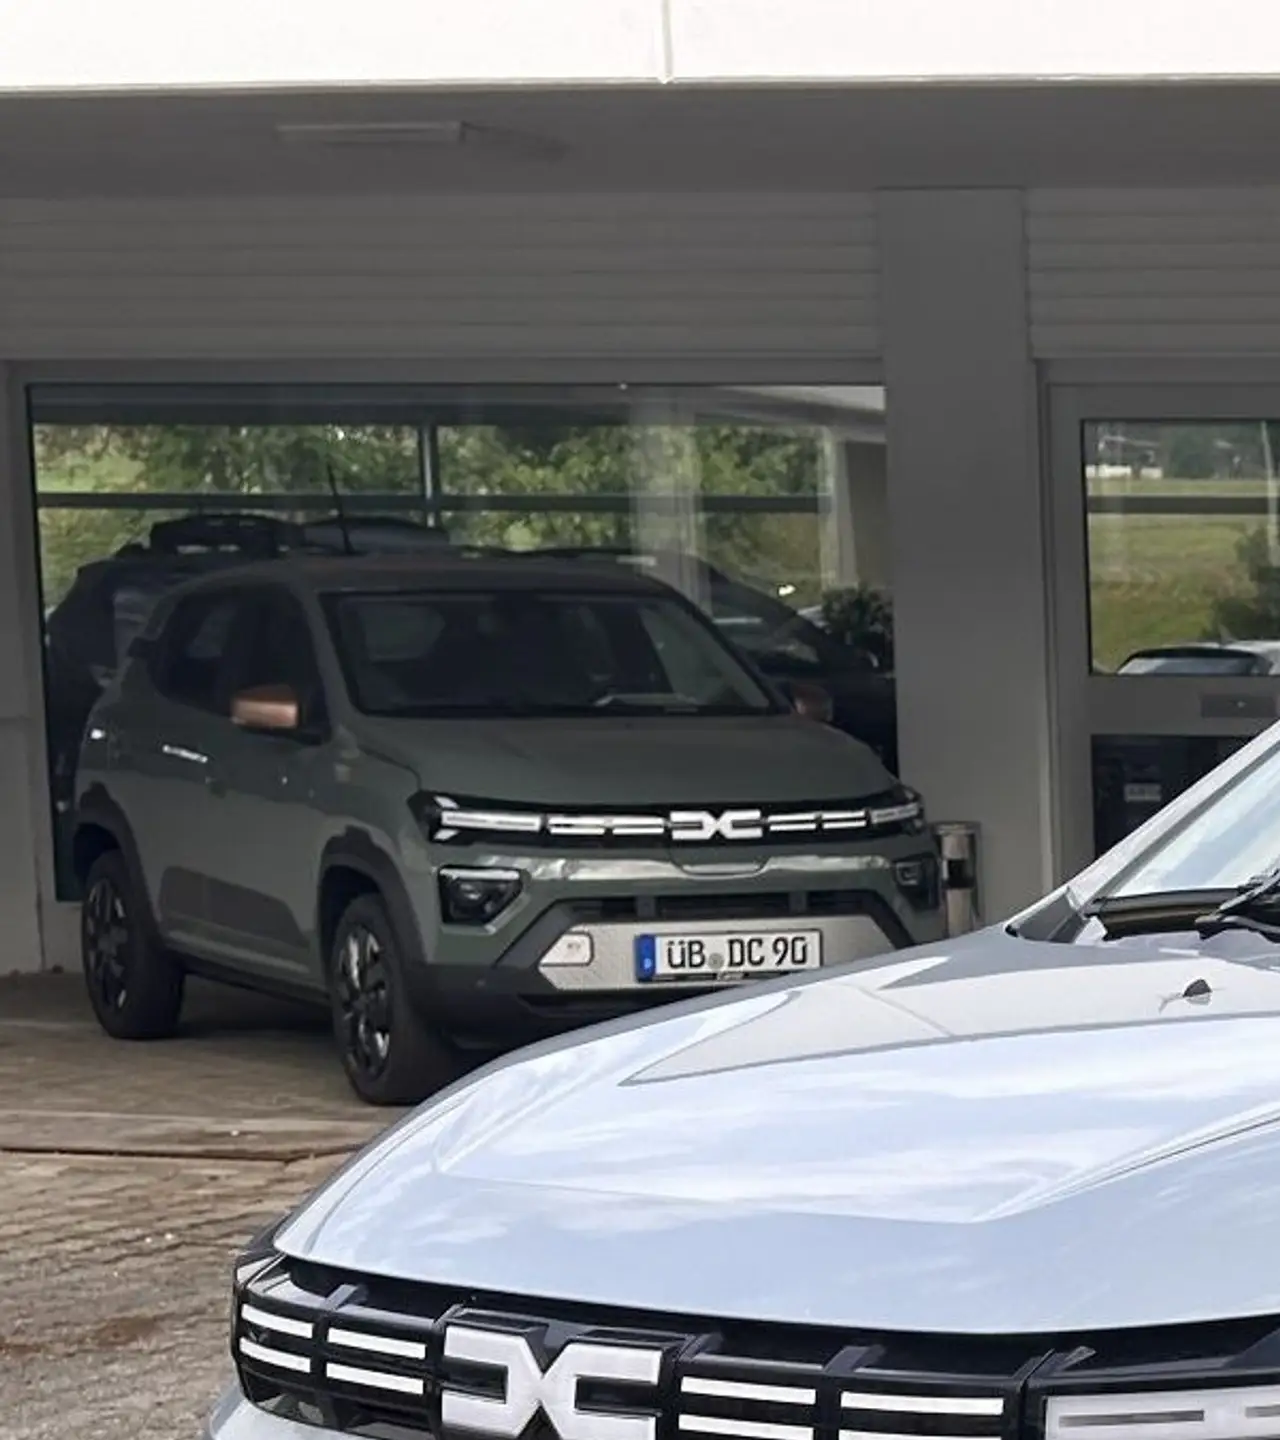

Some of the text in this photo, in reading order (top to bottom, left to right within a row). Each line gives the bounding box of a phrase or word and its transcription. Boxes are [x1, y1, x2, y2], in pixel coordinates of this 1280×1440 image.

[668, 936, 808, 969] ÜB DC 90
